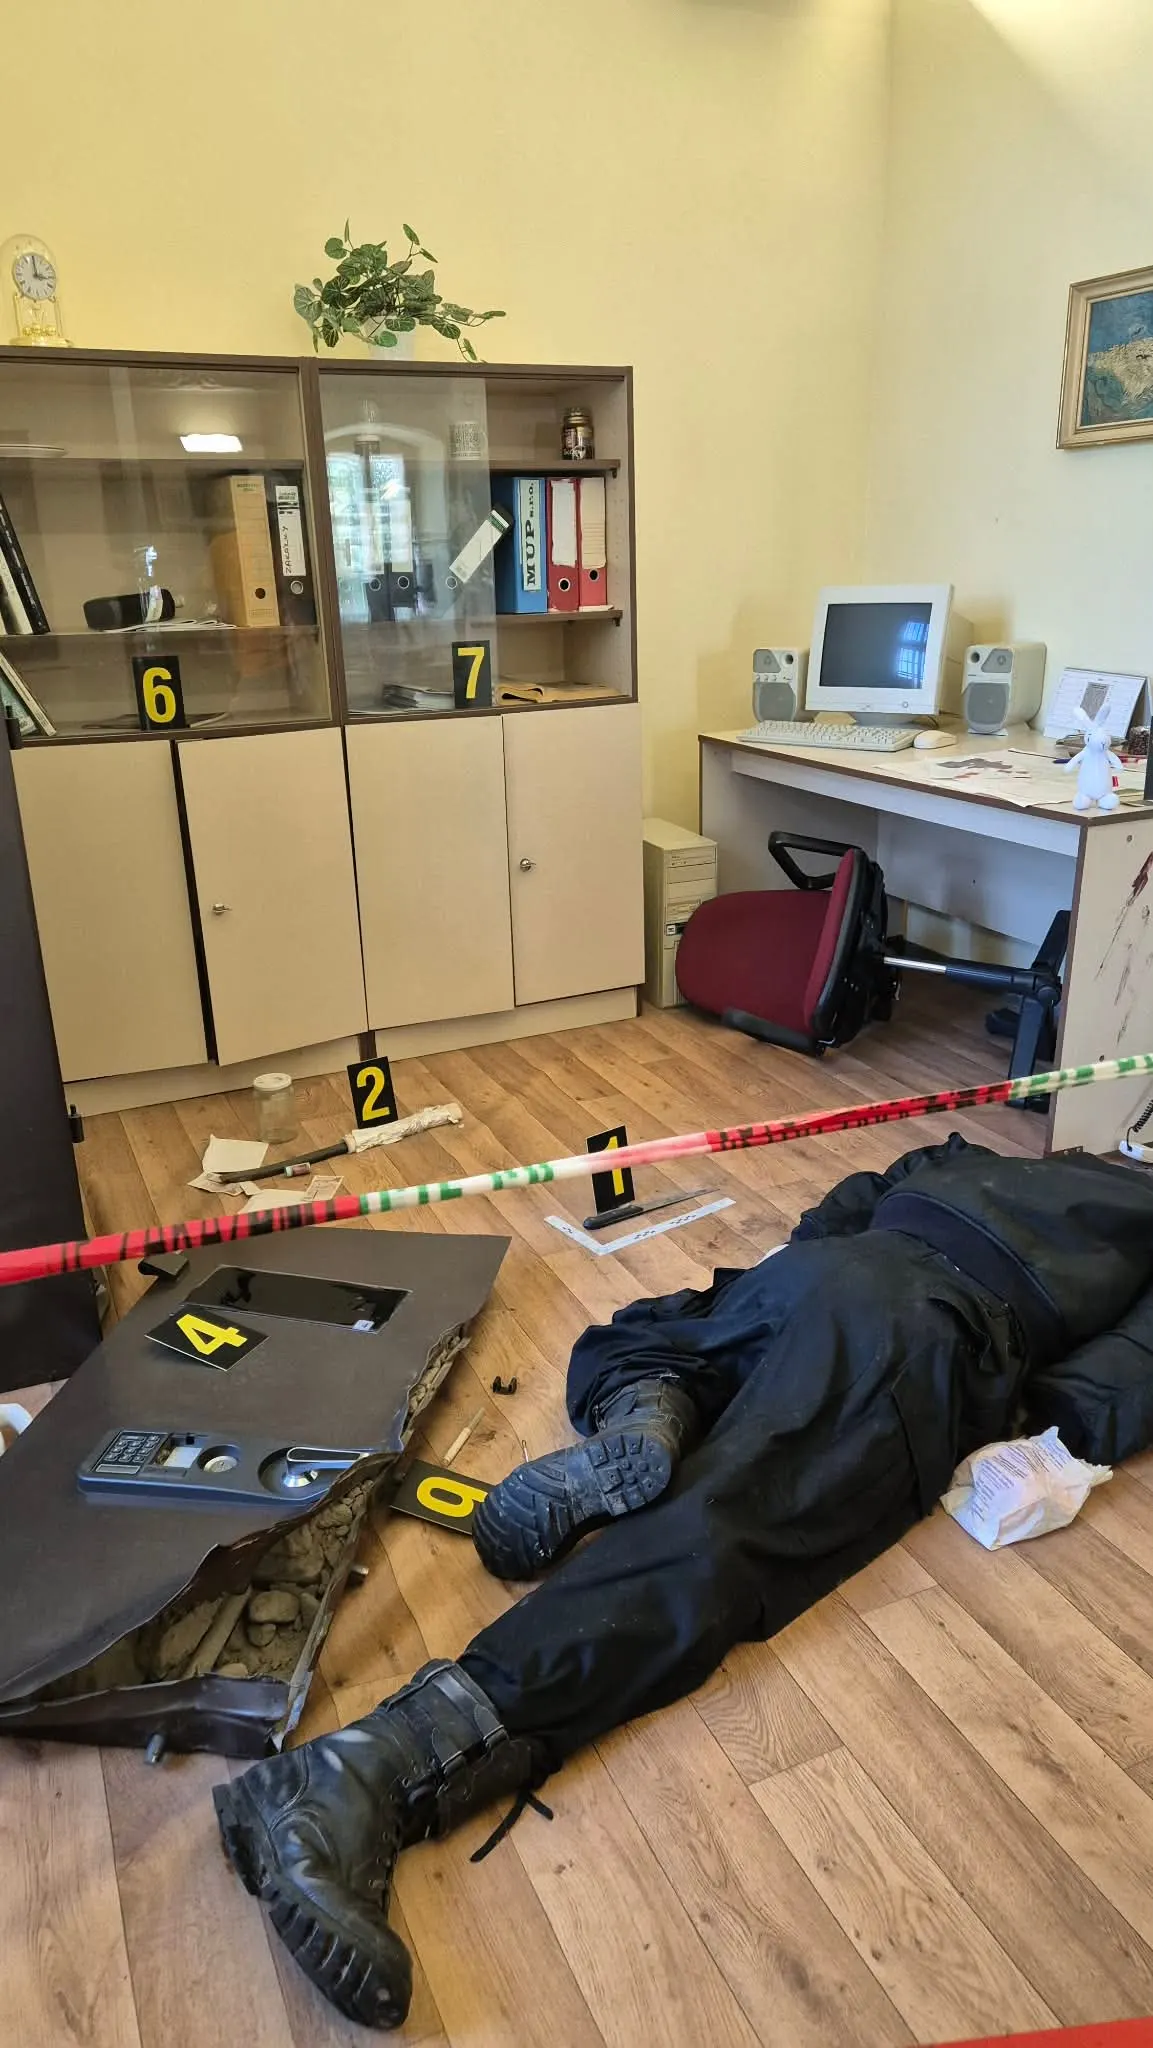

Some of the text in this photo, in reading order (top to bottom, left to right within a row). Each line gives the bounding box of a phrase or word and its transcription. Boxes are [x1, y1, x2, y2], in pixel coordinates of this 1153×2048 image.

[525, 519, 536, 586] MUP
[143, 668, 175, 723] 6
[457, 648, 485, 698] 7
[356, 1067, 389, 1120] 2
[605, 1137, 625, 1196] 1
[176, 1314, 247, 1355] 4
